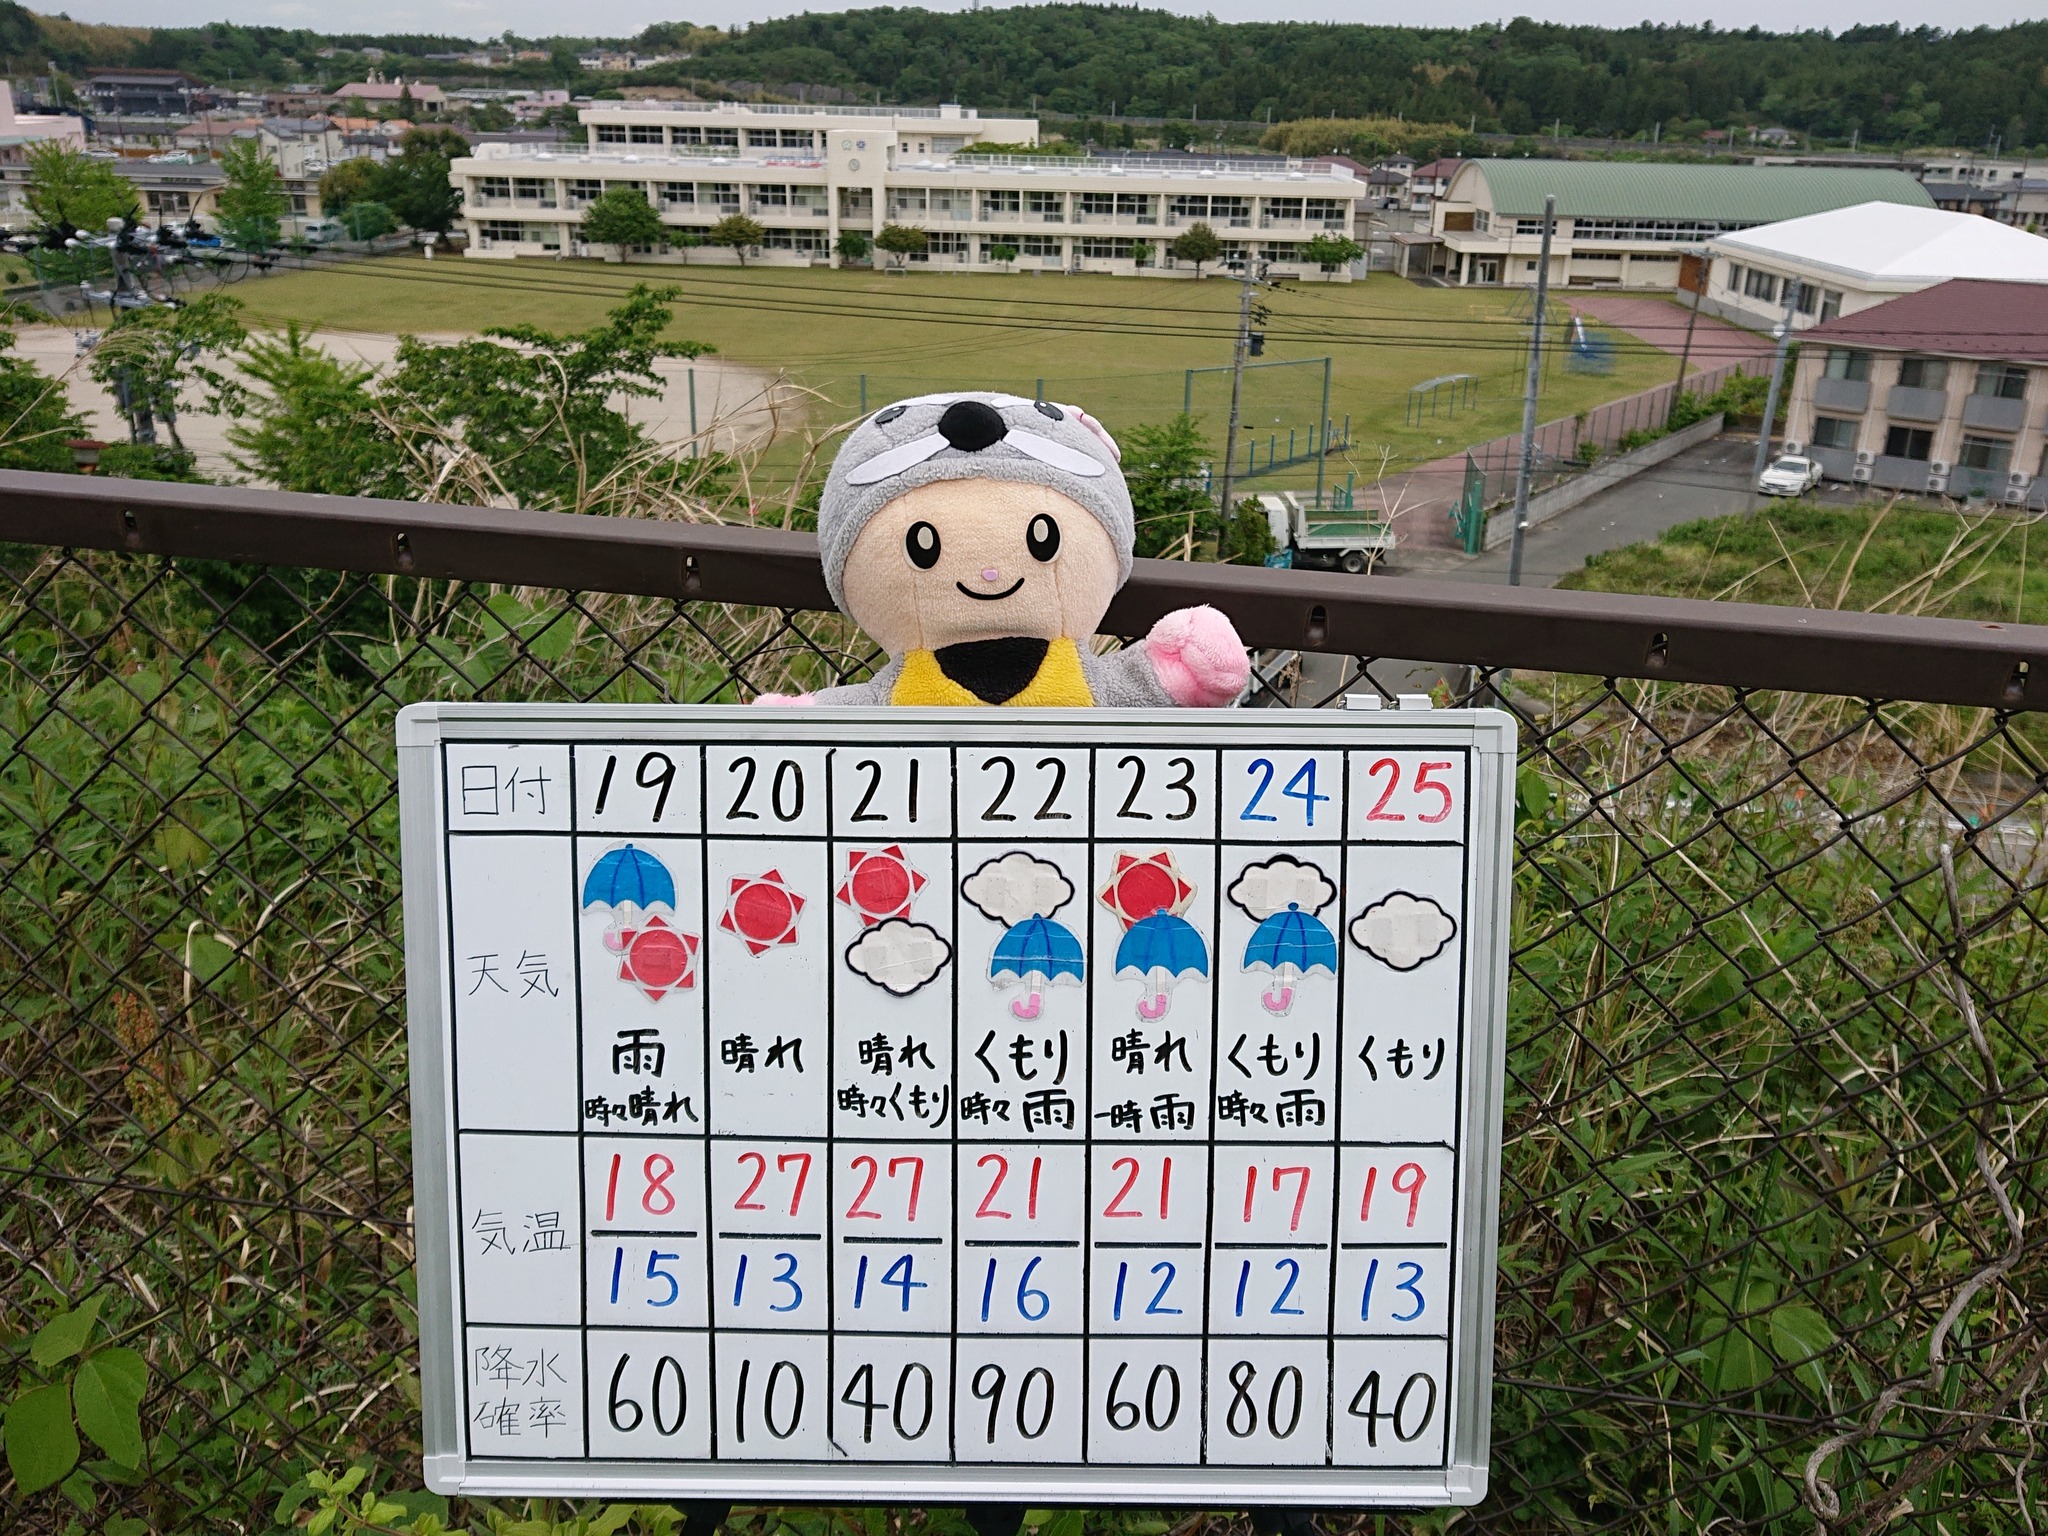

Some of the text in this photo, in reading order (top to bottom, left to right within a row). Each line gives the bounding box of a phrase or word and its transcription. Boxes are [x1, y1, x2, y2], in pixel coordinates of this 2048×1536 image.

[461, 765, 552, 815] 日付
[594, 751, 677, 823] 19
[725, 755, 805, 822] 20
[849, 758, 919, 823] 21
[980, 755, 1073, 822] 22
[1116, 755, 1198, 820] 23
[1239, 757, 1331, 827] 24
[1365, 757, 1453, 823] 25
[467, 949, 559, 998] 天気
[612, 1028, 665, 1077] 雨
[721, 1032, 805, 1074] 晴れ
[858, 1031, 935, 1076] 晴れ
[974, 1029, 1068, 1085] くもり
[1111, 1027, 1193, 1075] 晴れ
[1227, 1031, 1321, 1080] くもり
[1357, 1034, 1446, 1081] くもり
[584, 1089, 699, 1127] 時々晴れ
[837, 1081, 950, 1129] 時々くもり
[605, 1153, 676, 1221] 18
[734, 1152, 811, 1216] 27
[846, 1155, 924, 1221] 27
[976, 1154, 1042, 1219] 21
[1103, 1156, 1172, 1219] 21
[1243, 1166, 1310, 1231] 17
[1361, 1163, 1427, 1228] 19
[472, 1209, 571, 1255] 気温
[610, 1247, 680, 1306] 15
[733, 1253, 802, 1312] 13
[854, 1253, 928, 1312] 14
[981, 1256, 1050, 1321] 16
[1113, 1261, 1183, 1321] 12
[1236, 1258, 1304, 1317] 12
[1361, 1258, 1425, 1321] 13
[474, 1344, 567, 1388] 降水
[608, 1353, 686, 1436] 60
[1106, 1362, 1181, 1431] 60
[474, 1397, 567, 1438] 確率
[736, 1359, 805, 1443] 10
[841, 1362, 933, 1443] 40
[971, 1363, 1054, 1444] 90
[1226, 1360, 1302, 1439] 80
[1348, 1370, 1436, 1447] 40
